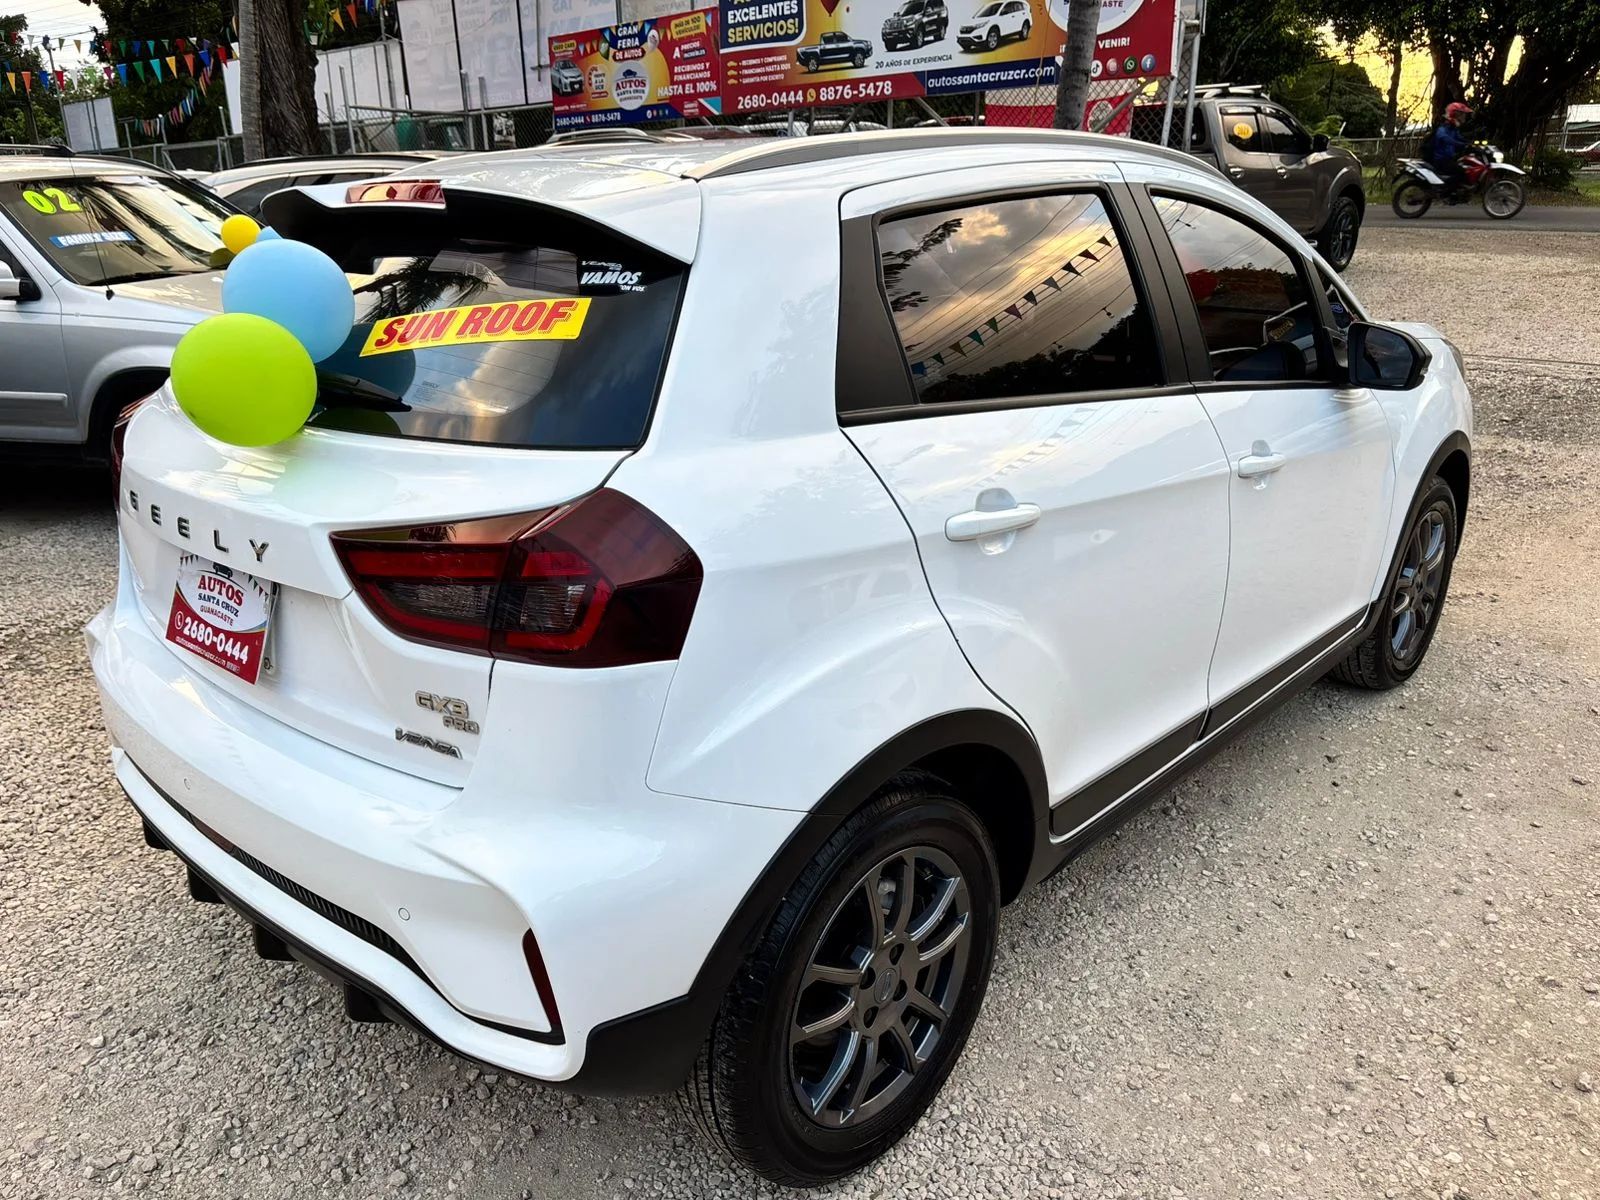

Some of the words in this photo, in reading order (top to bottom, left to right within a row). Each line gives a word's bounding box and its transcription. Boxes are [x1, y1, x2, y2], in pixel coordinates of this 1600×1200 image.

[727, 1, 798, 24] EXCELENTES
[617, 25, 638, 37] GRAN
[727, 18, 799, 43] SERVICIOS!
[617, 37, 640, 49] FERIA
[673, 47, 681, 59] A
[1097, 36, 1130, 49] VENIR!
[615, 52, 624, 60] DE
[624, 49, 642, 59] AUTOS
[706, 61, 710, 69] Y
[875, 60, 885, 69] 20
[885, 58, 902, 68] AÑOS
[912, 54, 953, 65] EXPERIENCIA
[615, 78, 647, 91] AUTOS
[927, 65, 1055, 88] autossantacruzcr.com
[657, 84, 683, 97] HASTA
[684, 83, 695, 94] EL
[695, 80, 717, 93] 100%
[737, 89, 803, 109] 2680-0444
[819, 80, 892, 101] 8876-5478
[22, 187, 82, 214] 02
[580, 271, 642, 285] VAMOS
[374, 309, 459, 350] SUN
[456, 300, 579, 340] ROOF
[129, 489, 270, 563] GEELY
[197, 574, 244, 607] AUTOS
[198, 592, 221, 607] SANTA
[221, 600, 240, 618] CRUZ
[200, 604, 234, 627] GUANACASTE
[183, 616, 250, 665] 2680-0444
[394, 727, 463, 760] VENGA
